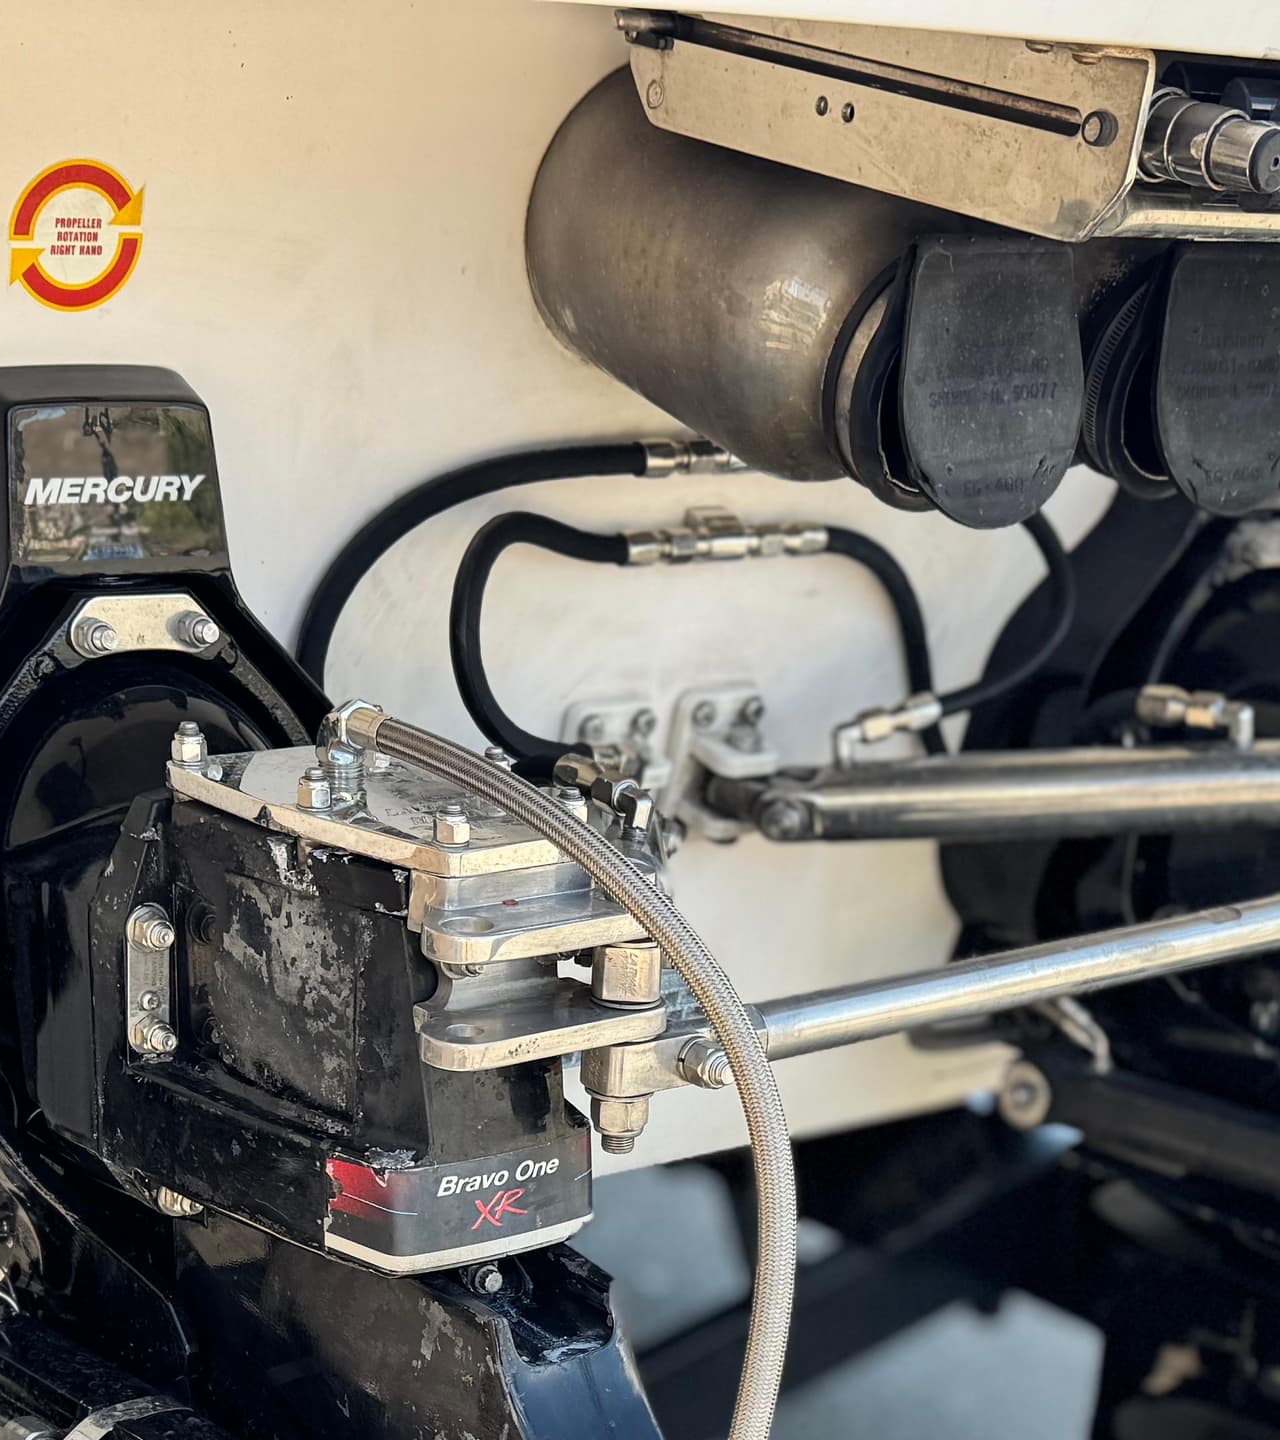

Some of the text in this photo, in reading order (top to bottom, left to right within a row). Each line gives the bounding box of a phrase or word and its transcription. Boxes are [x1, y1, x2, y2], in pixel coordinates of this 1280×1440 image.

[55, 217, 103, 229] PROPELLER
[56, 231, 99, 243] ROTATION
[50, 244, 103, 256] RIGHT HAND
[24, 474, 207, 506] MERCURY
[437, 1156, 560, 1198] Bravo One
[472, 1187, 529, 1231] XR
